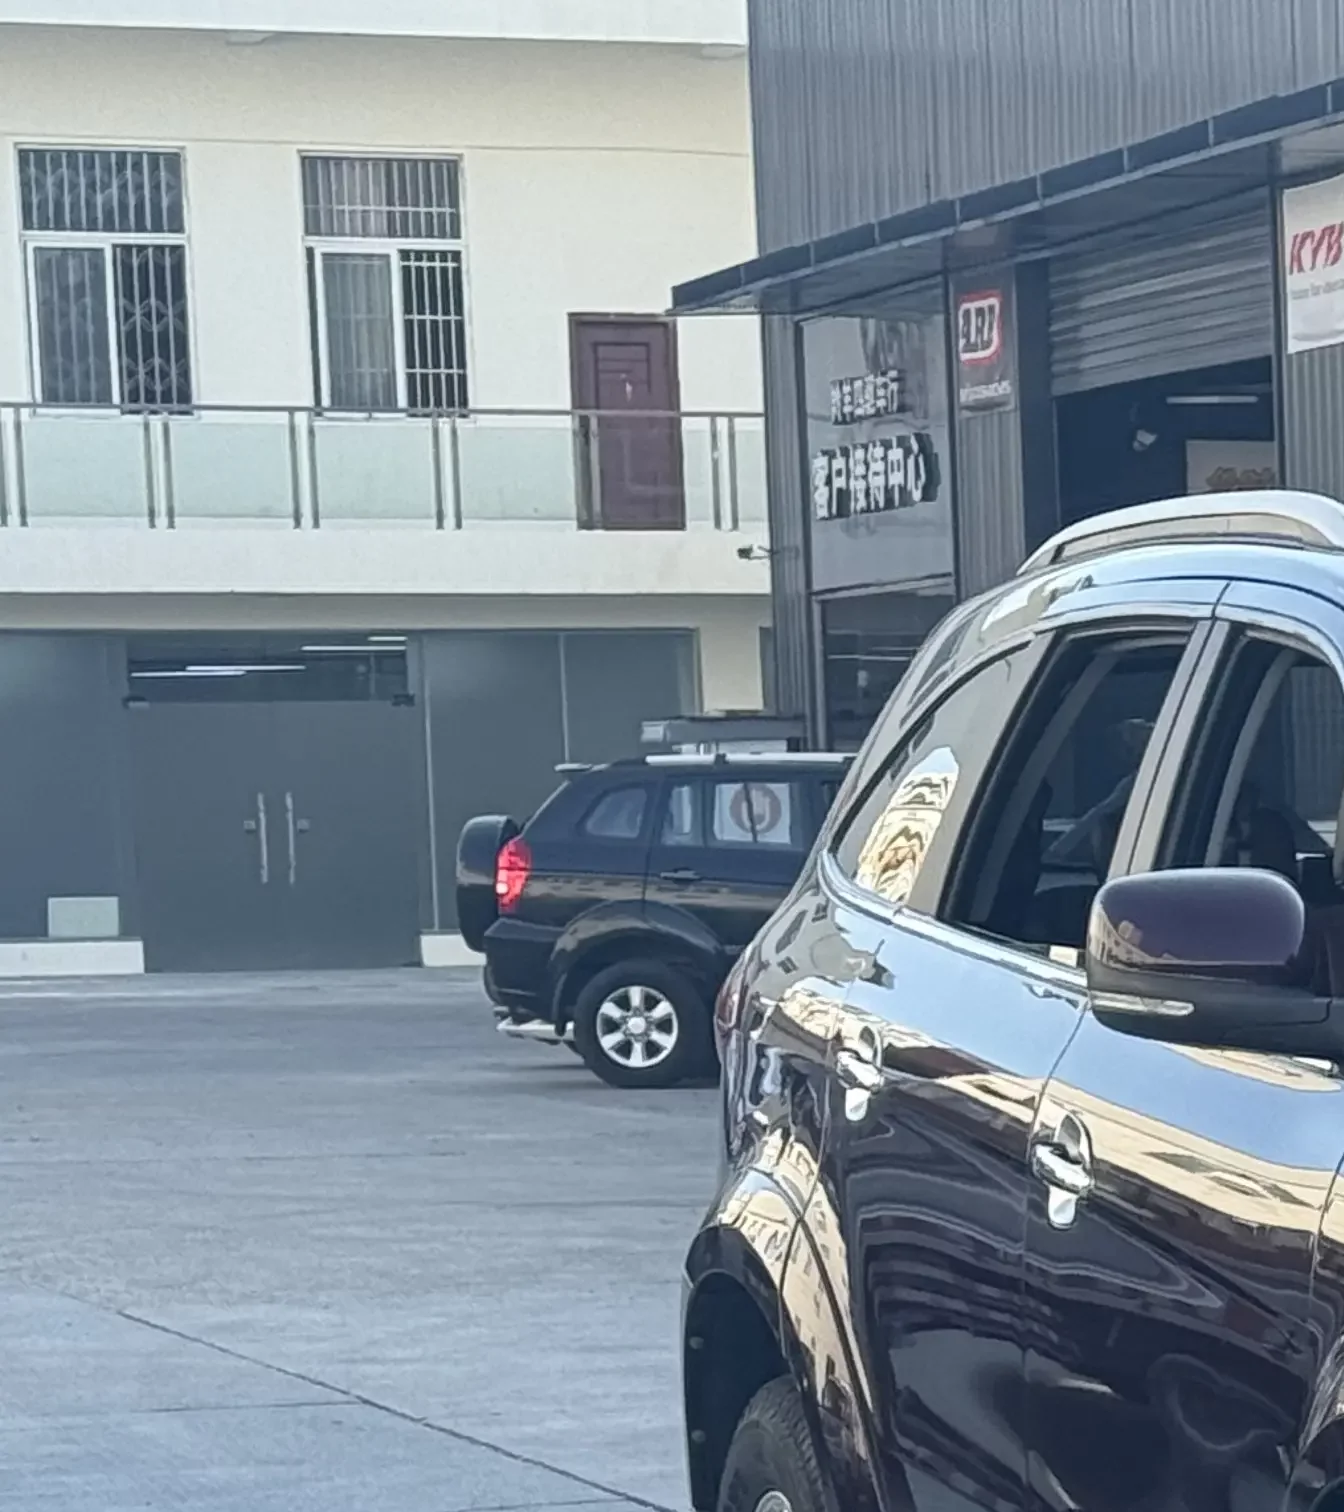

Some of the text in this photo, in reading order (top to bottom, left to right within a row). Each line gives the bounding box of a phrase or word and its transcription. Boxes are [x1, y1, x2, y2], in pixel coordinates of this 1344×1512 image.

[1289, 220, 1344, 276] KYB
[812, 431, 926, 520] 客户接待中心
